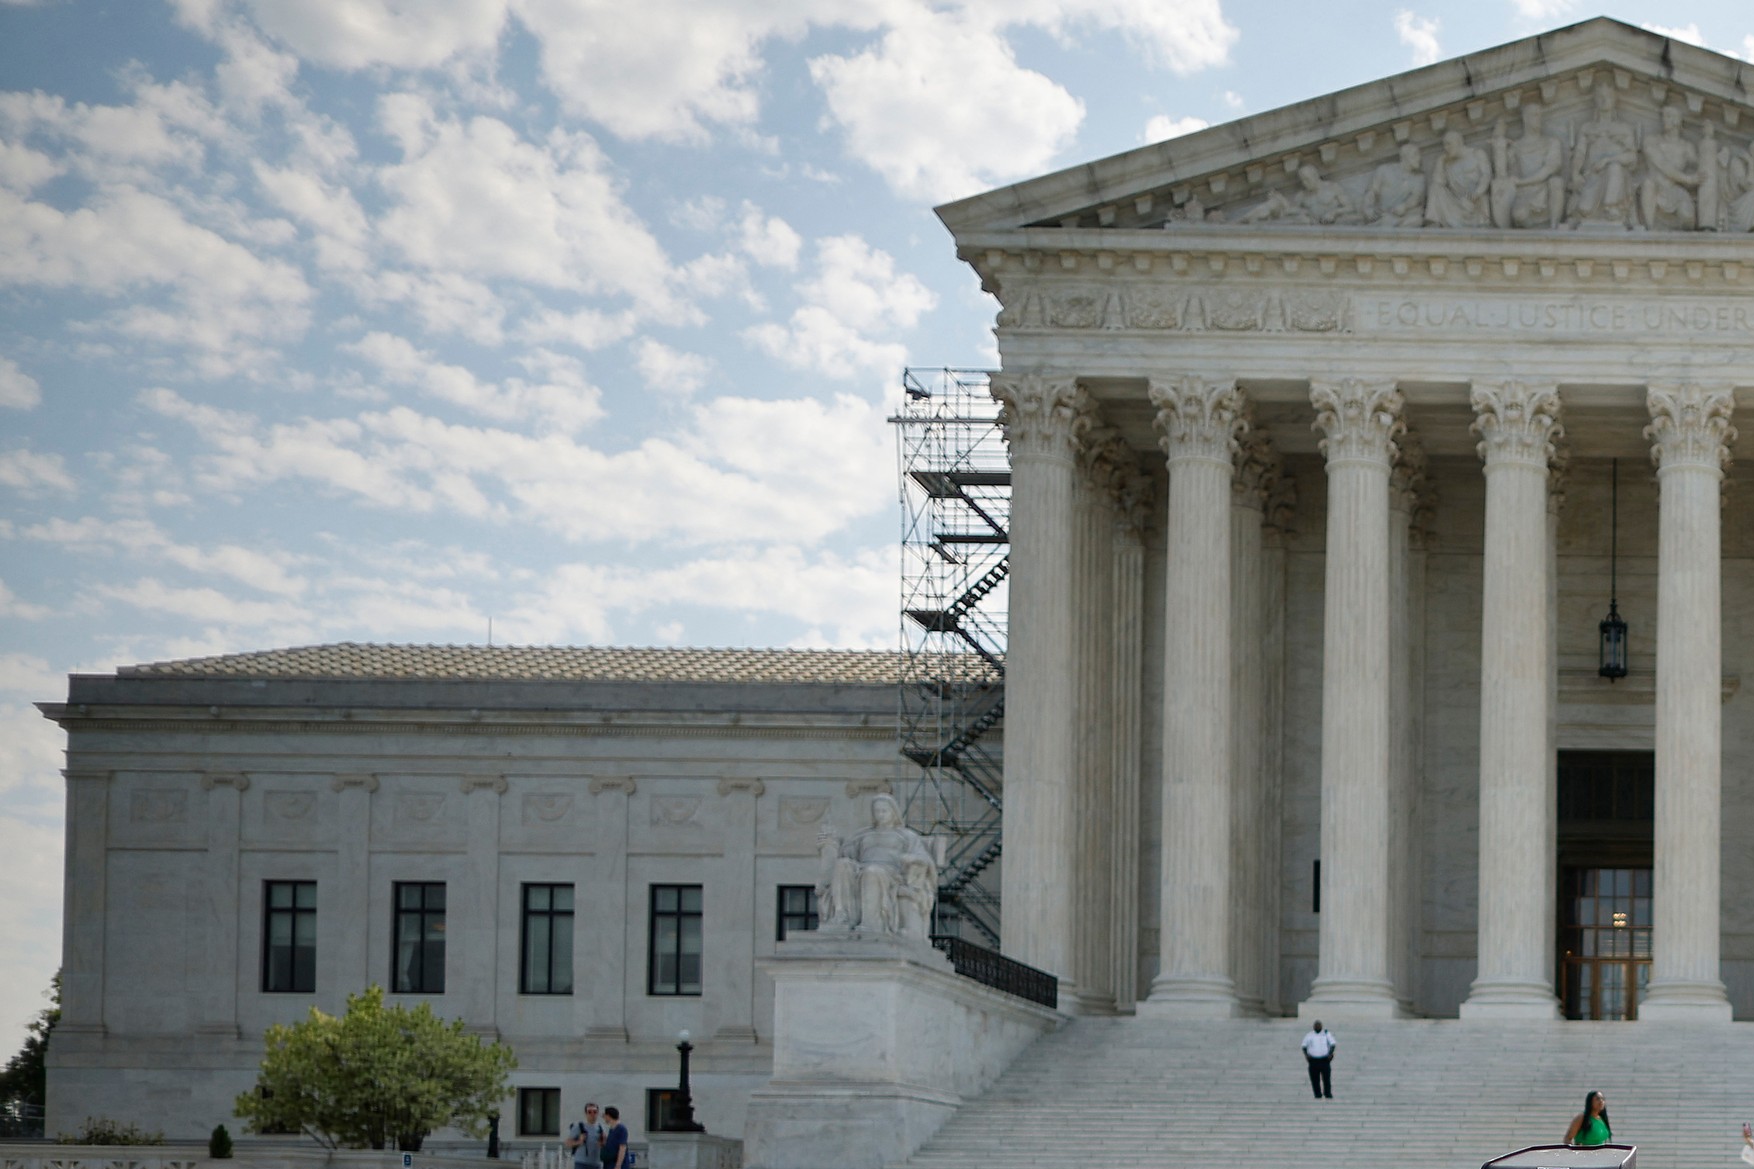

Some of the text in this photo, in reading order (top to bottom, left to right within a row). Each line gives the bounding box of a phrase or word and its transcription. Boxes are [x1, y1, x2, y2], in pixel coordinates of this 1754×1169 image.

[1377, 301, 1489, 328] EQUAL
[1497, 302, 1626, 330] JUSTICE
[1643, 305, 1754, 332] UNDER
